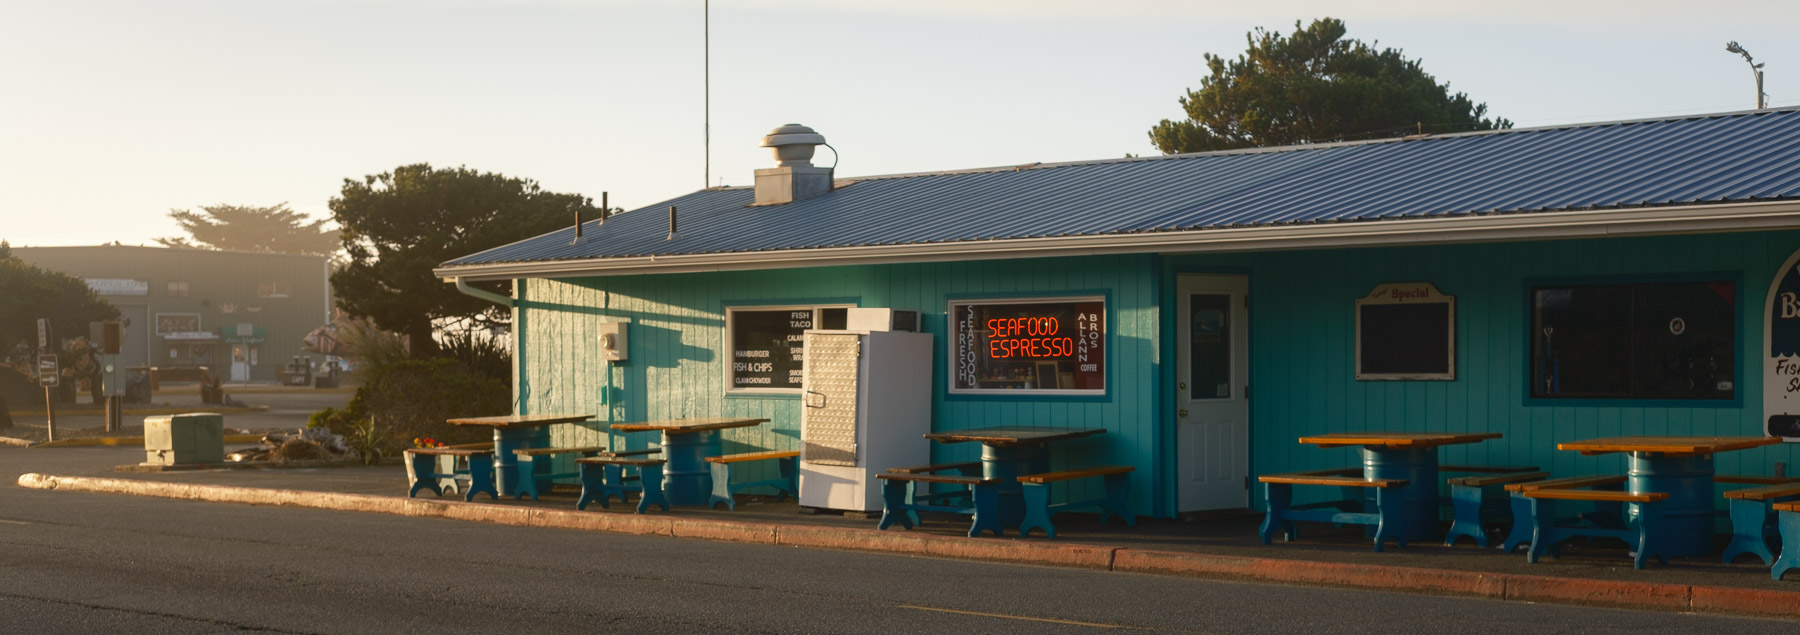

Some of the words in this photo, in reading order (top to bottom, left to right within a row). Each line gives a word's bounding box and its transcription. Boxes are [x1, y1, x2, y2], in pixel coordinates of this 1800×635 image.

[1392, 287, 1429, 301] Special
[789, 320, 811, 328] TACO
[987, 316, 1059, 338] SEAFOOD
[1089, 313, 1099, 348] BROS
[967, 305, 976, 386] SEAFOOD
[990, 337, 1073, 358] ESPRESSO
[1077, 312, 1088, 362] ALLANN
[735, 350, 770, 358] HAMBURGER
[959, 320, 967, 381] FRESH
[733, 362, 747, 372] FISH
[747, 363, 753, 371] &
[753, 363, 773, 372] CHIPS
[1080, 364, 1098, 372] COFFEE
